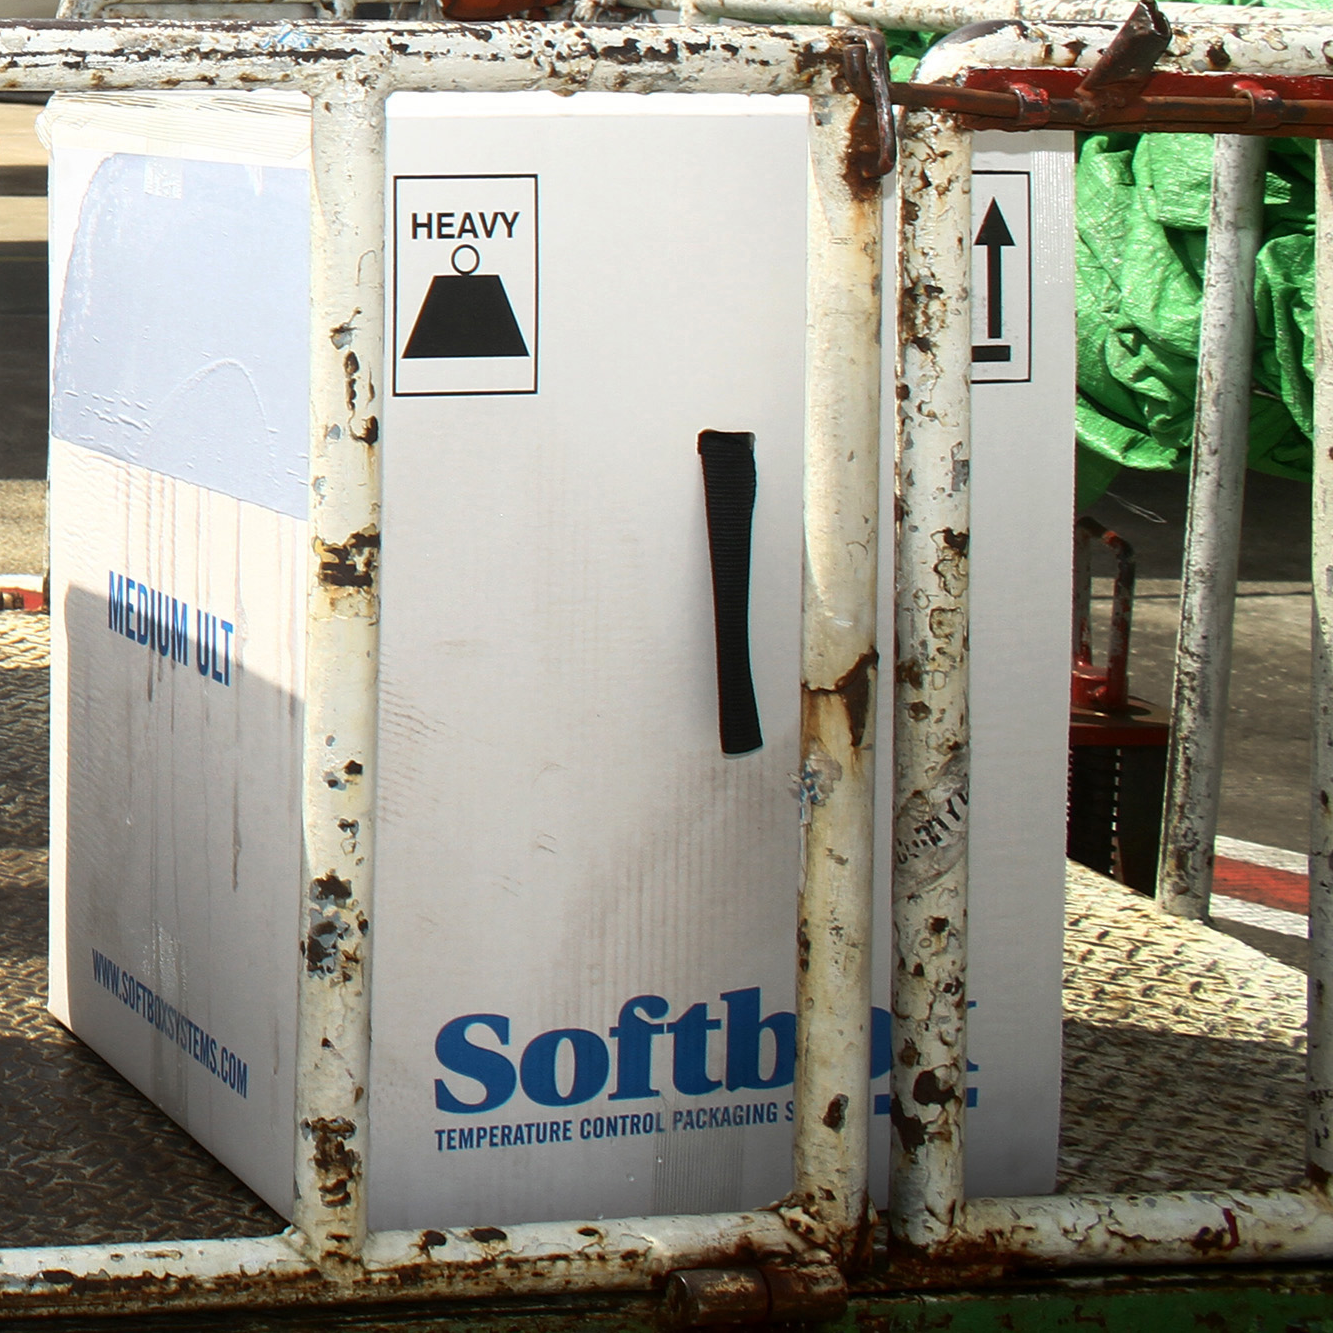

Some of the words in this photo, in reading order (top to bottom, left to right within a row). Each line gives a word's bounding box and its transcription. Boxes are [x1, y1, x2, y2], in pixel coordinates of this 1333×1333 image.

[411, 211, 520, 240] HEAVY
[108, 569, 188, 667] MEDIUM
[196, 608, 234, 687] ULT
[91, 947, 248, 1100] WWW.SOFTBOXSYSTEMS.COM
[435, 1119, 575, 1153] TEMPERATURE
[579, 1111, 666, 1139] CONTROL
[673, 1101, 780, 1132] PACKAGING
